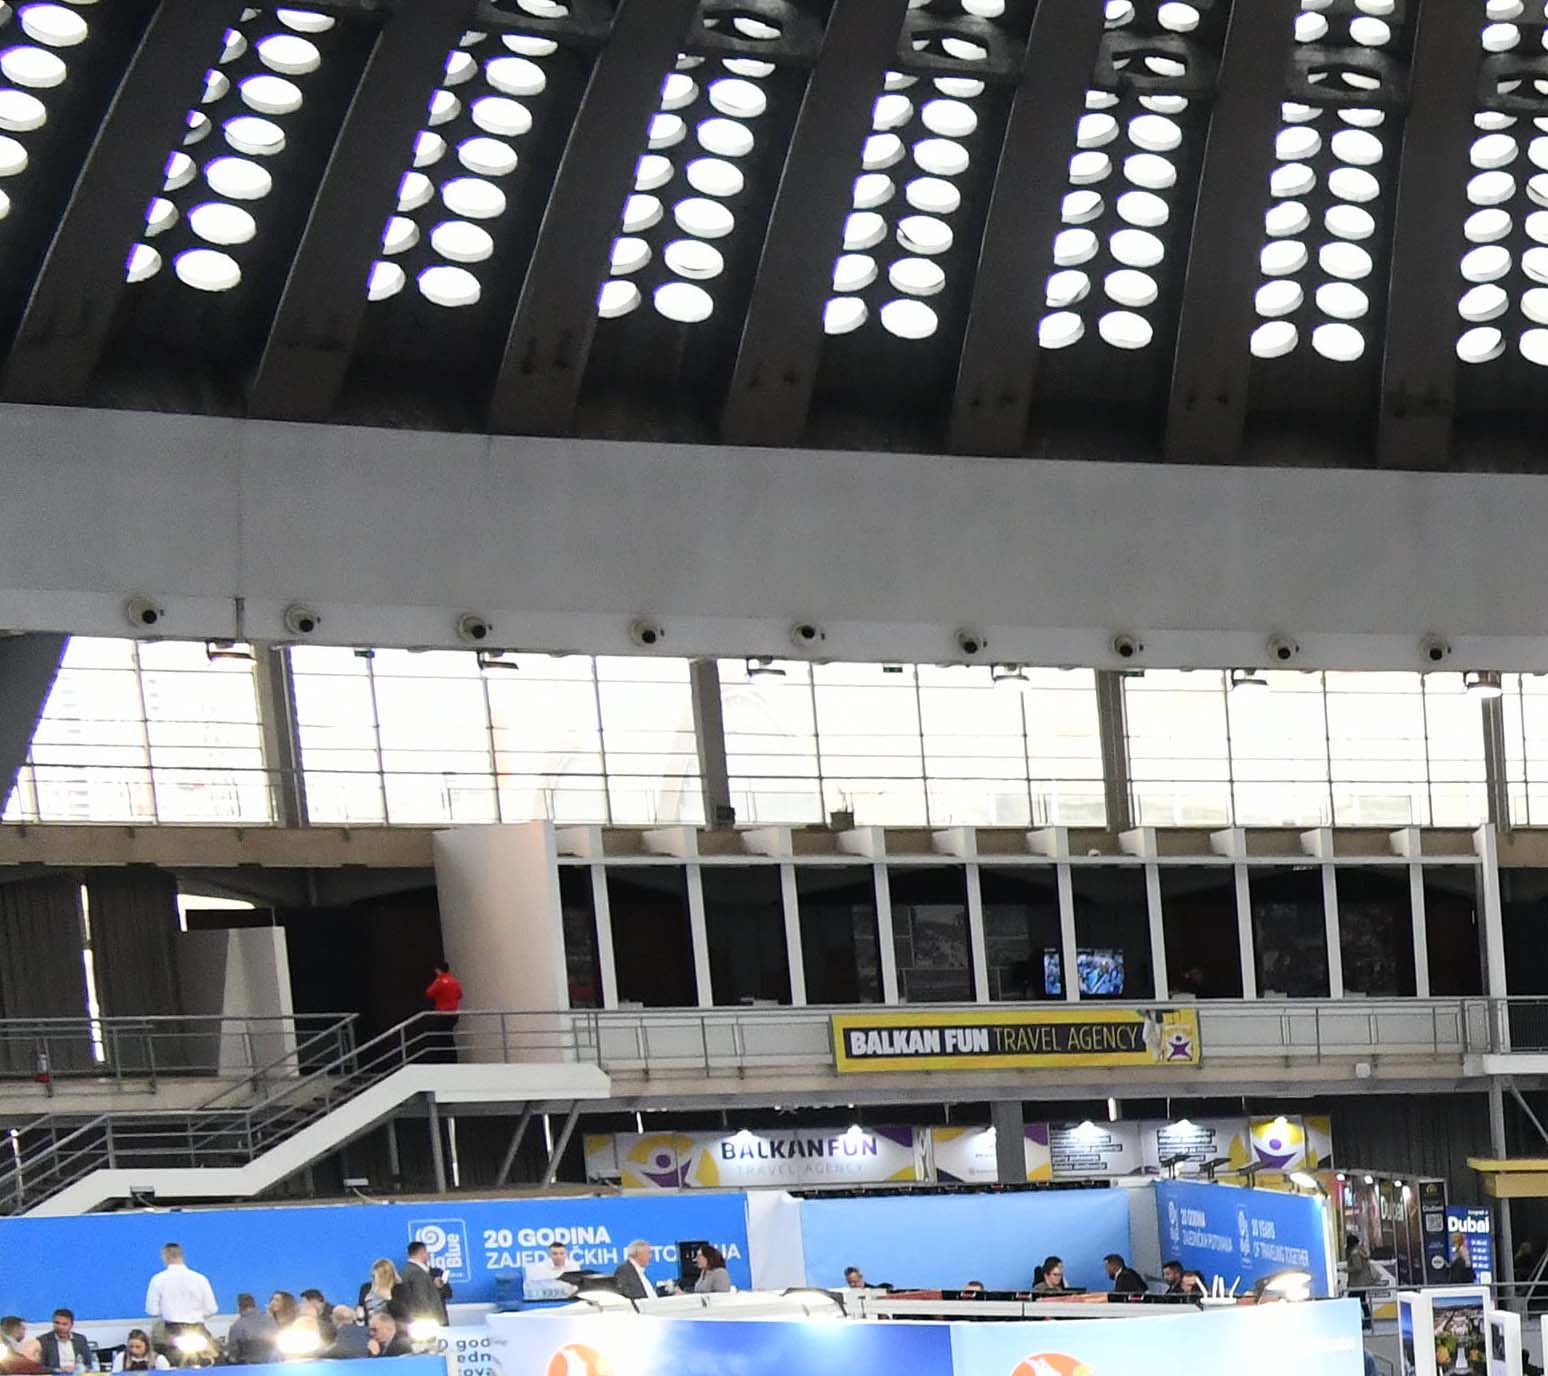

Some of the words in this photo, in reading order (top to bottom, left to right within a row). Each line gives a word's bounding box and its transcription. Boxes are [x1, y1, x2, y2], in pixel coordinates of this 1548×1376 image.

[850, 1028, 940, 1057] BALKAN
[946, 1027, 989, 1054] FUN
[992, 1026, 1062, 1053] TRAVEL
[1067, 1025, 1139, 1052] AGENCY
[1447, 1216, 1490, 1233] Dubai
[483, 1228, 513, 1248] 20
[518, 1225, 611, 1248] GODINA
